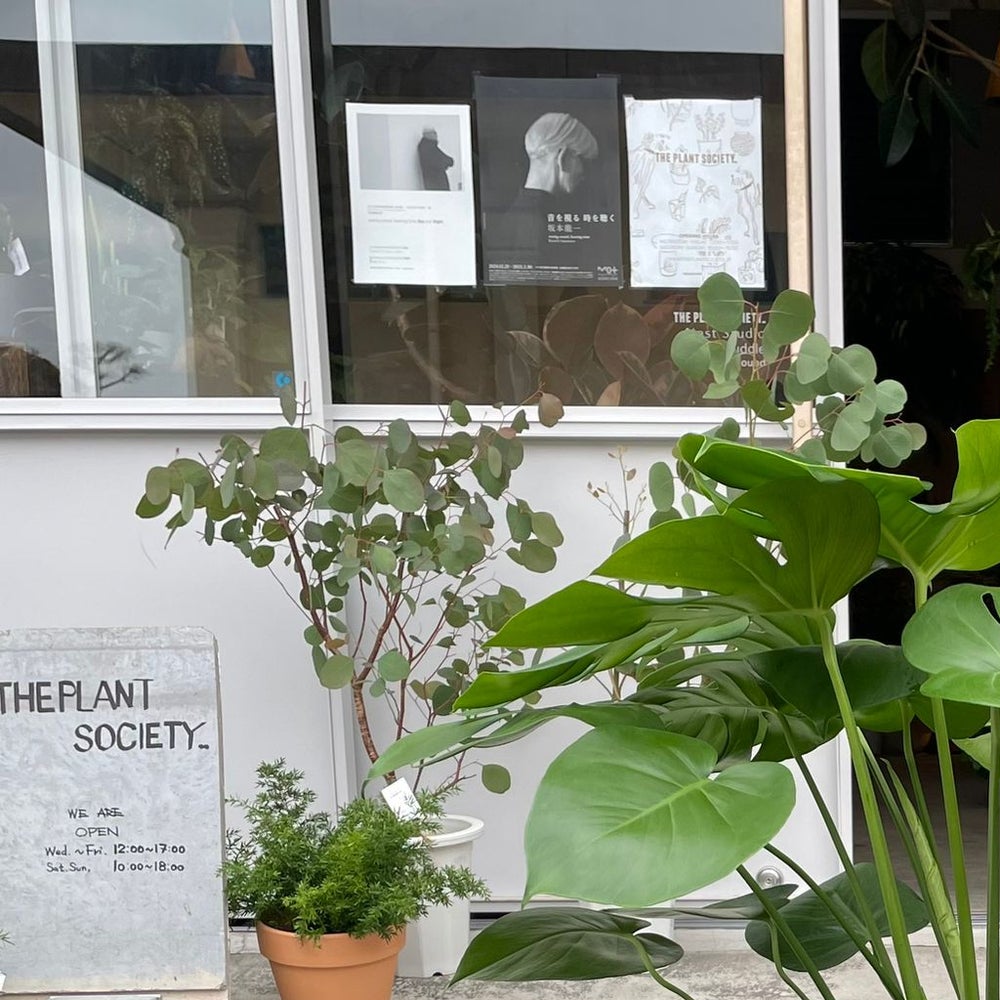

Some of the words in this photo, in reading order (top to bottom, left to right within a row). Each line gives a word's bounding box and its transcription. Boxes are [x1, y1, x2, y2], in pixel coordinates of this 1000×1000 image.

[656, 152, 671, 163] THE
[673, 152, 699, 164] PLANT
[673, 311, 691, 324] THE
[0, 681, 56, 714] THE
[58, 678, 154, 713] PLANT
[67, 808, 89, 819] WE
[97, 807, 124, 818] ARE
[74, 826, 119, 837] OPEN
